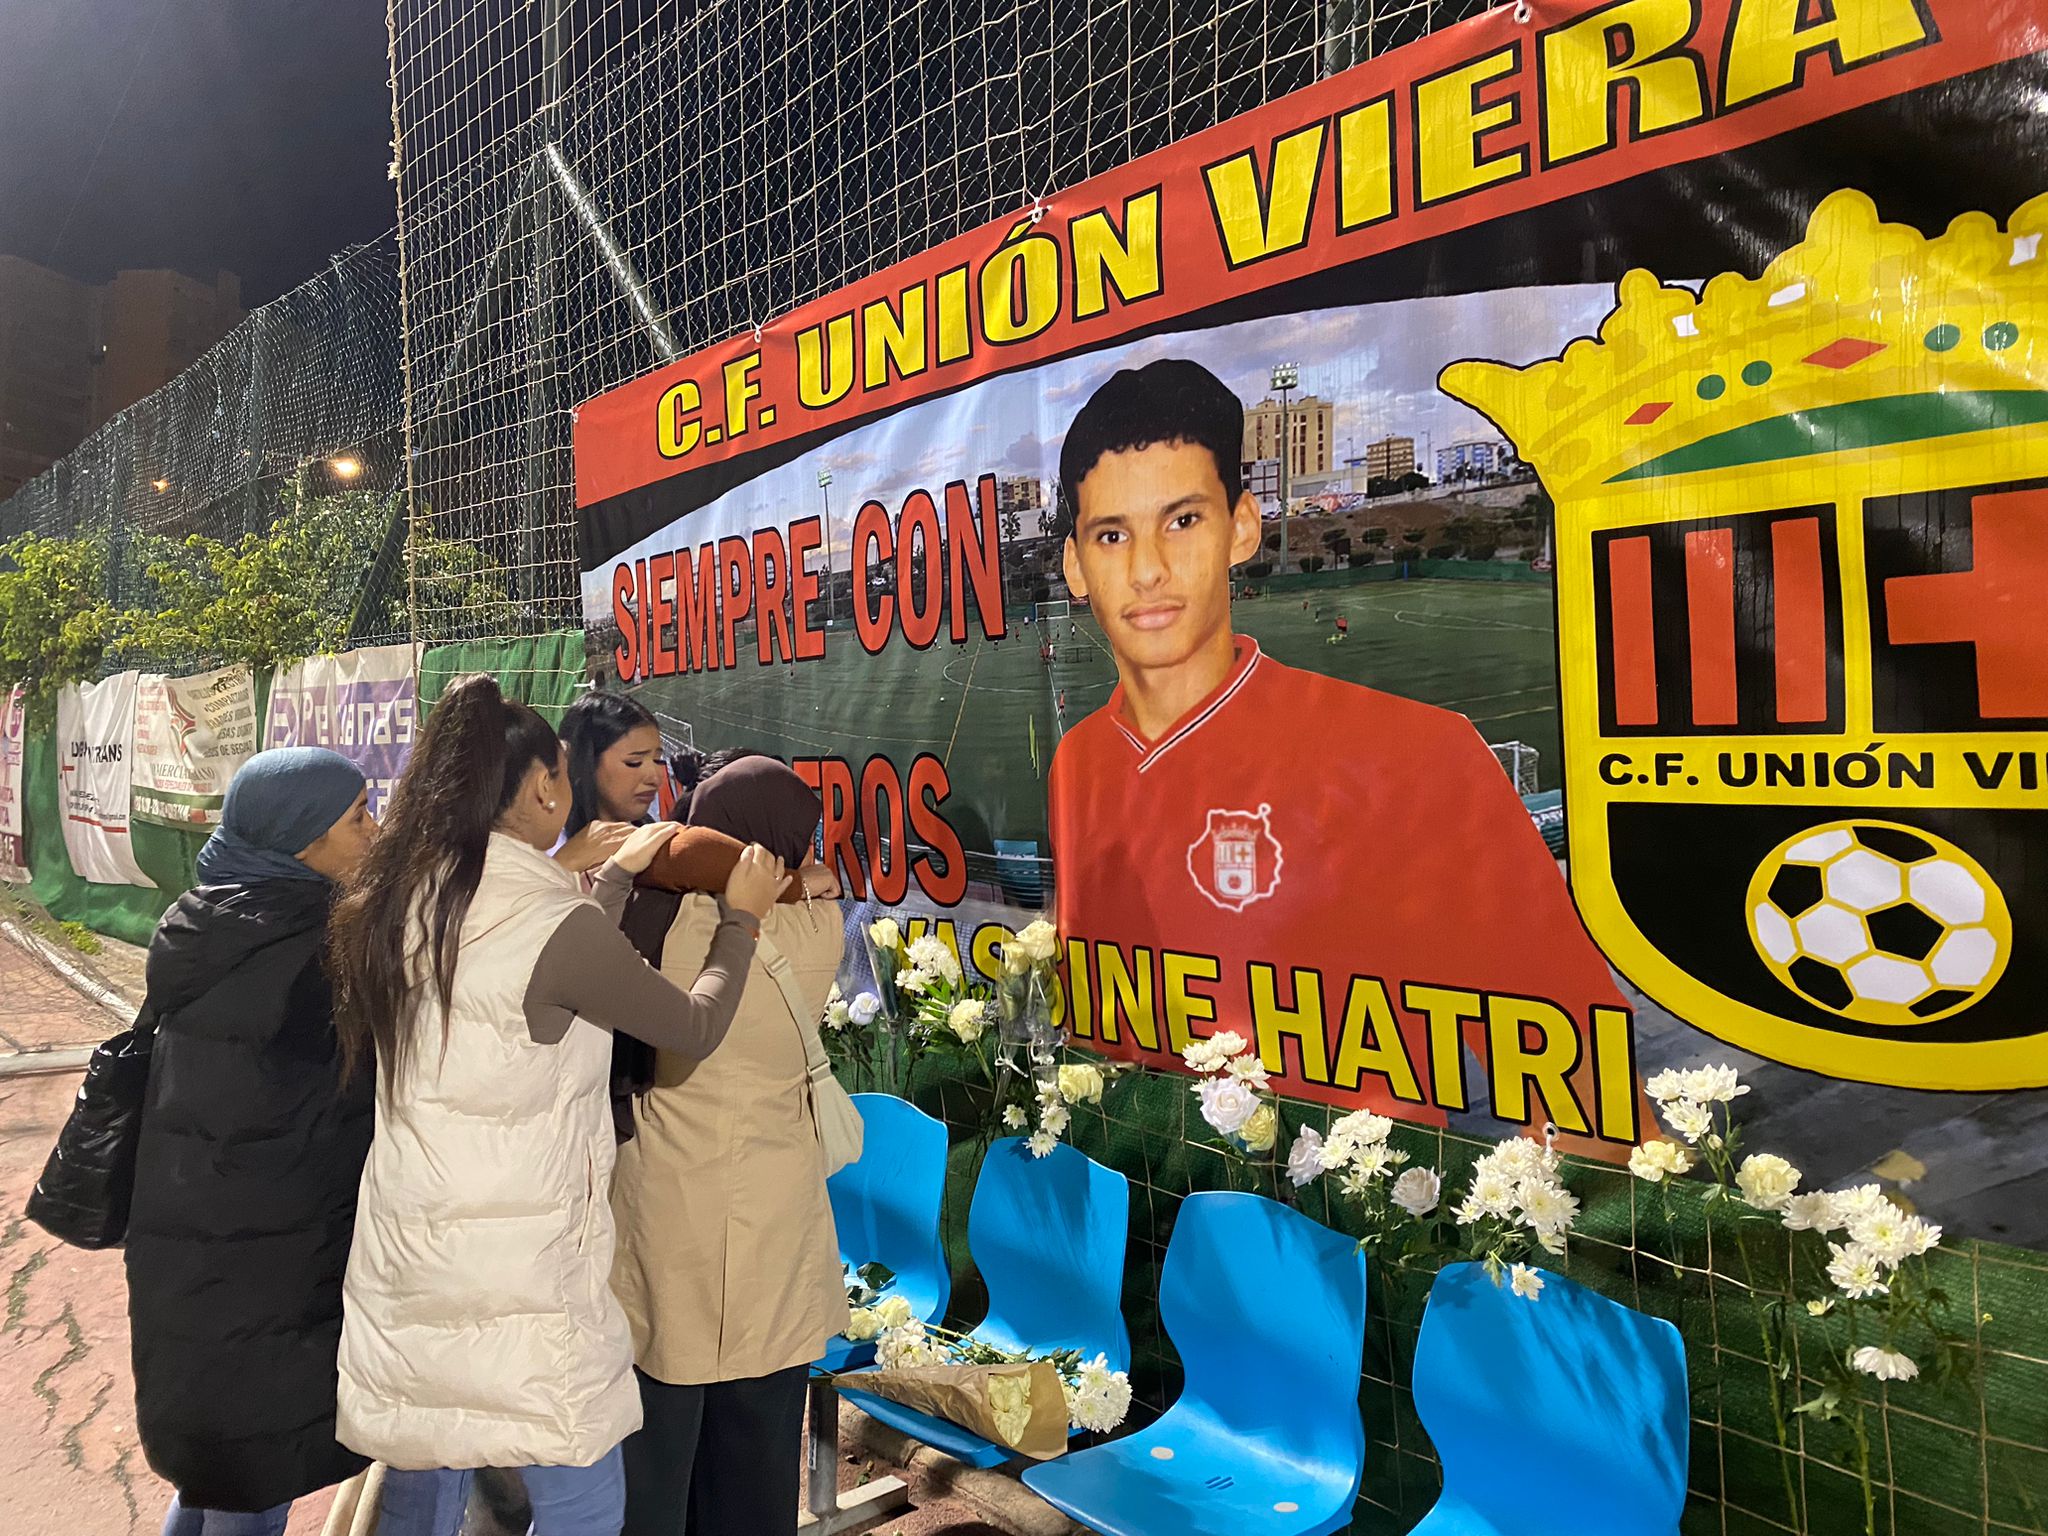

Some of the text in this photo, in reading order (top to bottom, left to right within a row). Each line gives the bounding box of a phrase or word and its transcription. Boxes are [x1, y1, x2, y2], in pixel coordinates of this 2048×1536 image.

[655, 0, 1941, 460] C.F. UNIÓN VIERA
[612, 472, 1007, 685] SIEMPRE CON
[1599, 742, 2048, 790] C.F. UNIÓN VI
[1246, 959, 1642, 1147] HATRI
